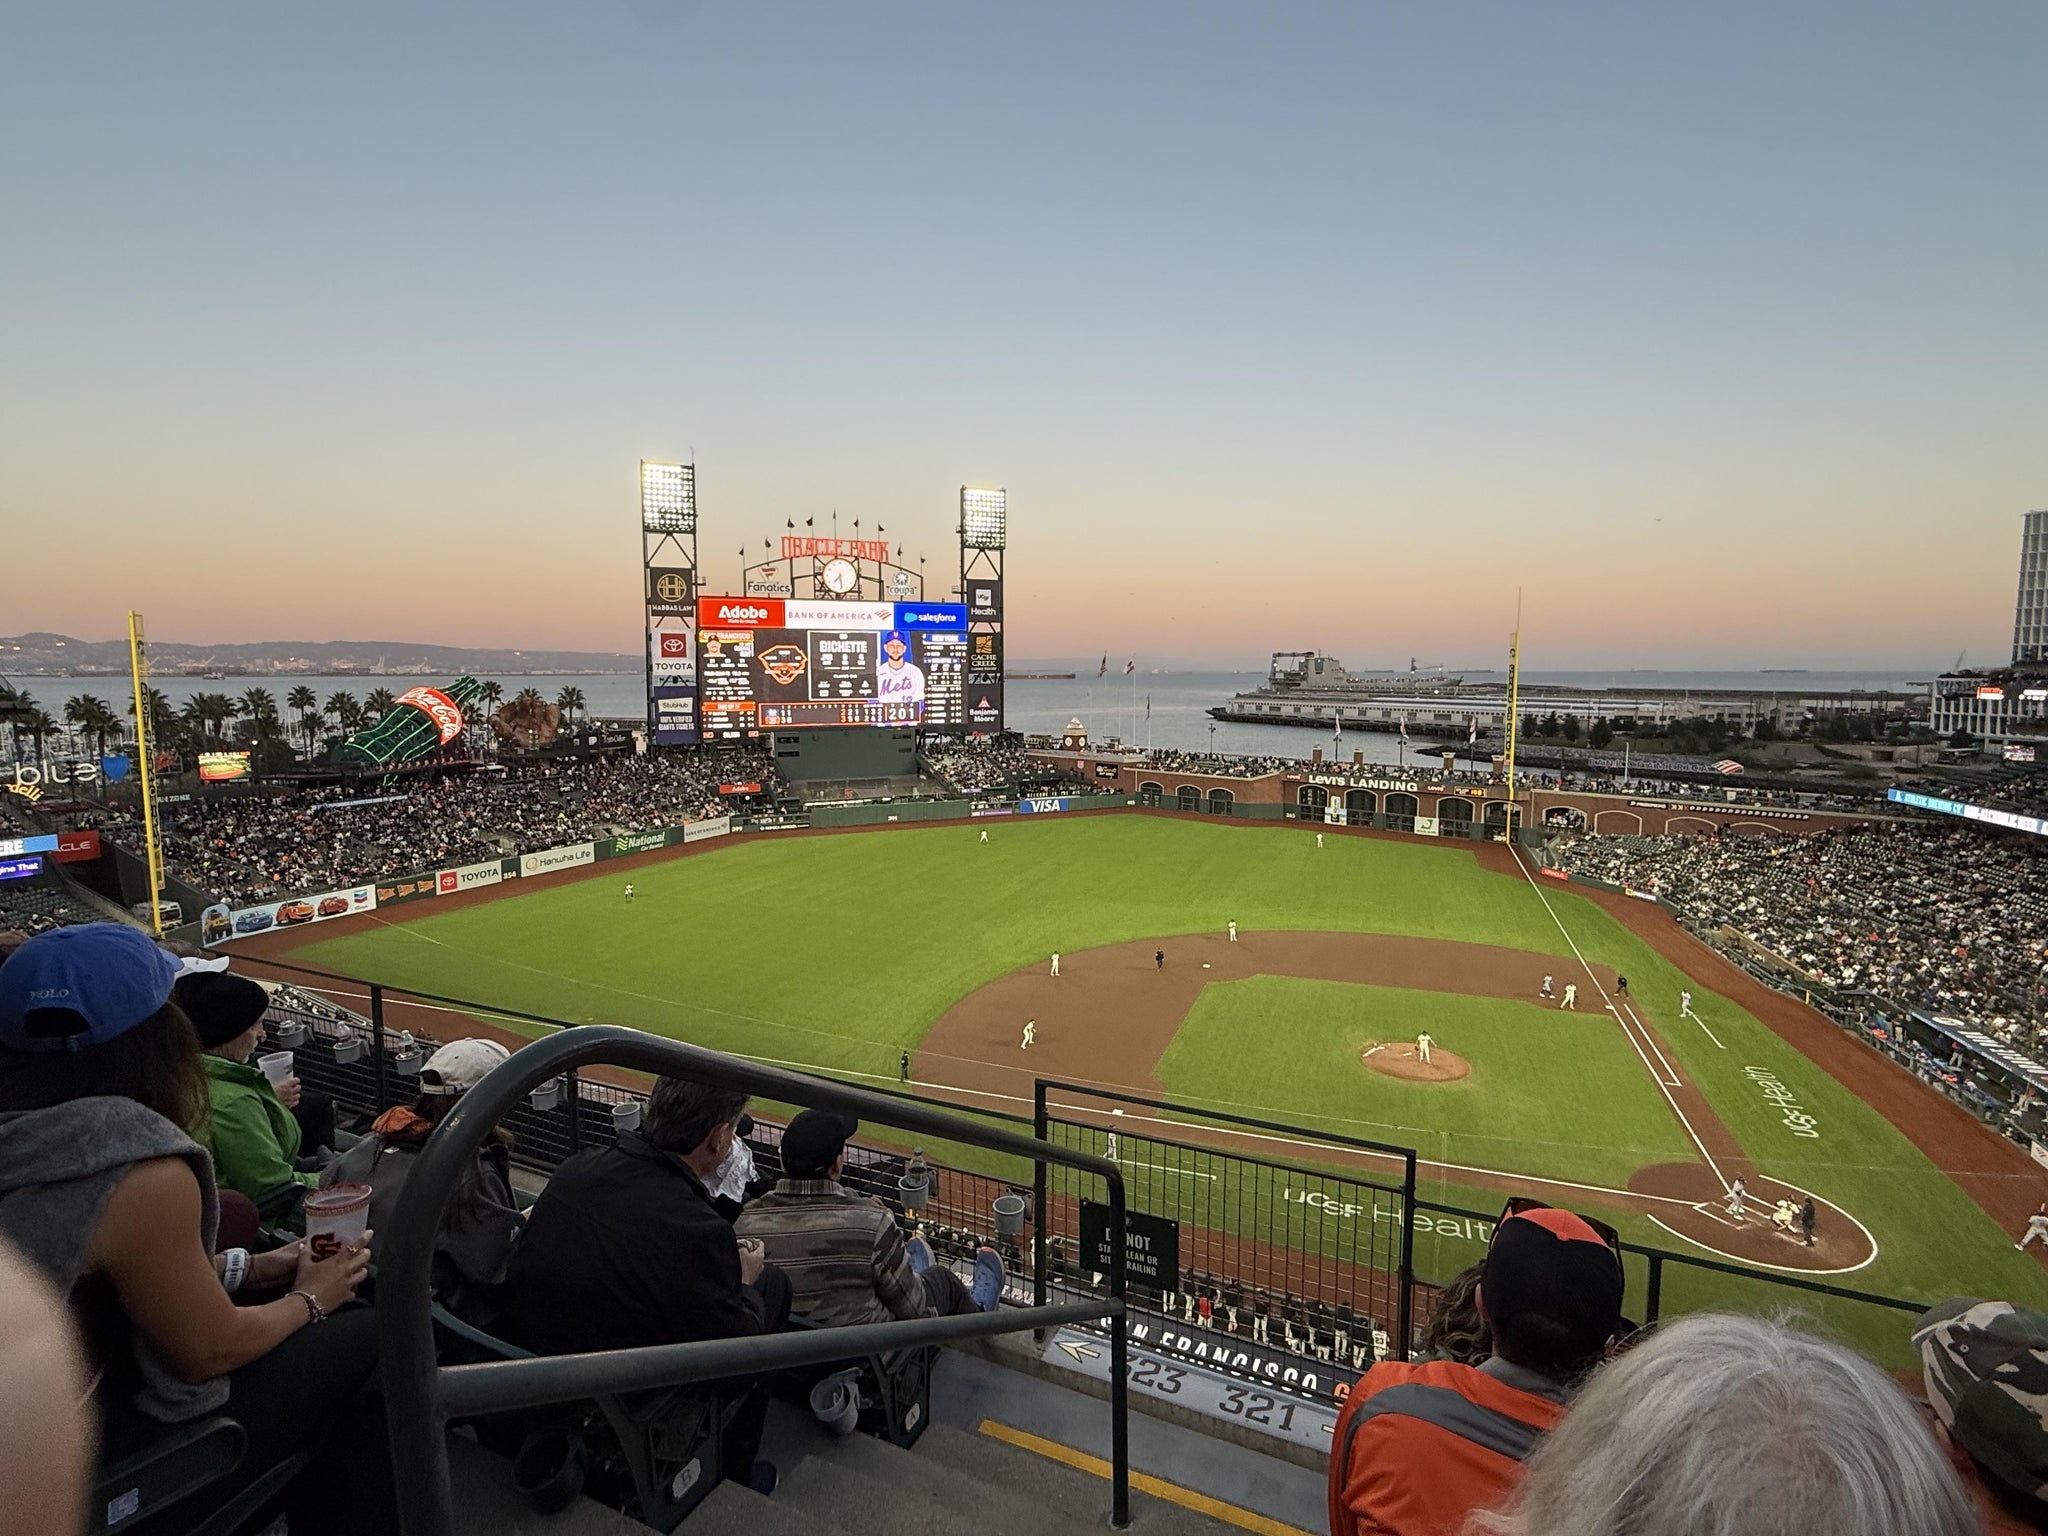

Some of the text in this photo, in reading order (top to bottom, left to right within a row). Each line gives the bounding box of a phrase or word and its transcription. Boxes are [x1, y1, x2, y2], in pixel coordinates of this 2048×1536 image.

[781, 536, 889, 564] ORACLE PARK
[747, 582, 791, 594] Fanatics
[718, 605, 768, 619] Adobe
[788, 611, 873, 620] BANK OF AMERICA
[918, 613, 957, 623] salesforce
[819, 640, 868, 653] BICHETTE
[655, 663, 693, 671] TOYOTA
[880, 676, 912, 696] Mets
[969, 708, 999, 716] Benjamin
[15, 760, 97, 785] blue
[1350, 778, 1418, 792] LANDING
[1030, 800, 1060, 812] VISA
[628, 831, 665, 849] National
[540, 850, 591, 867] Hanwha Life
[17, 862, 39, 872] That
[461, 868, 499, 883] TOYOTA
[30, 988, 70, 1000] POLO
[1740, 1066, 1819, 1138] UCSF Health
[1284, 1187, 1364, 1218] UCSF
[1126, 1232, 1151, 1251] NOT
[1100, 1255, 1157, 1276] SIT RAILING
[1126, 1250, 1145, 1263] LEAN
[1147, 1255, 1158, 1266] OR
[1219, 1384, 1296, 1432] 321
